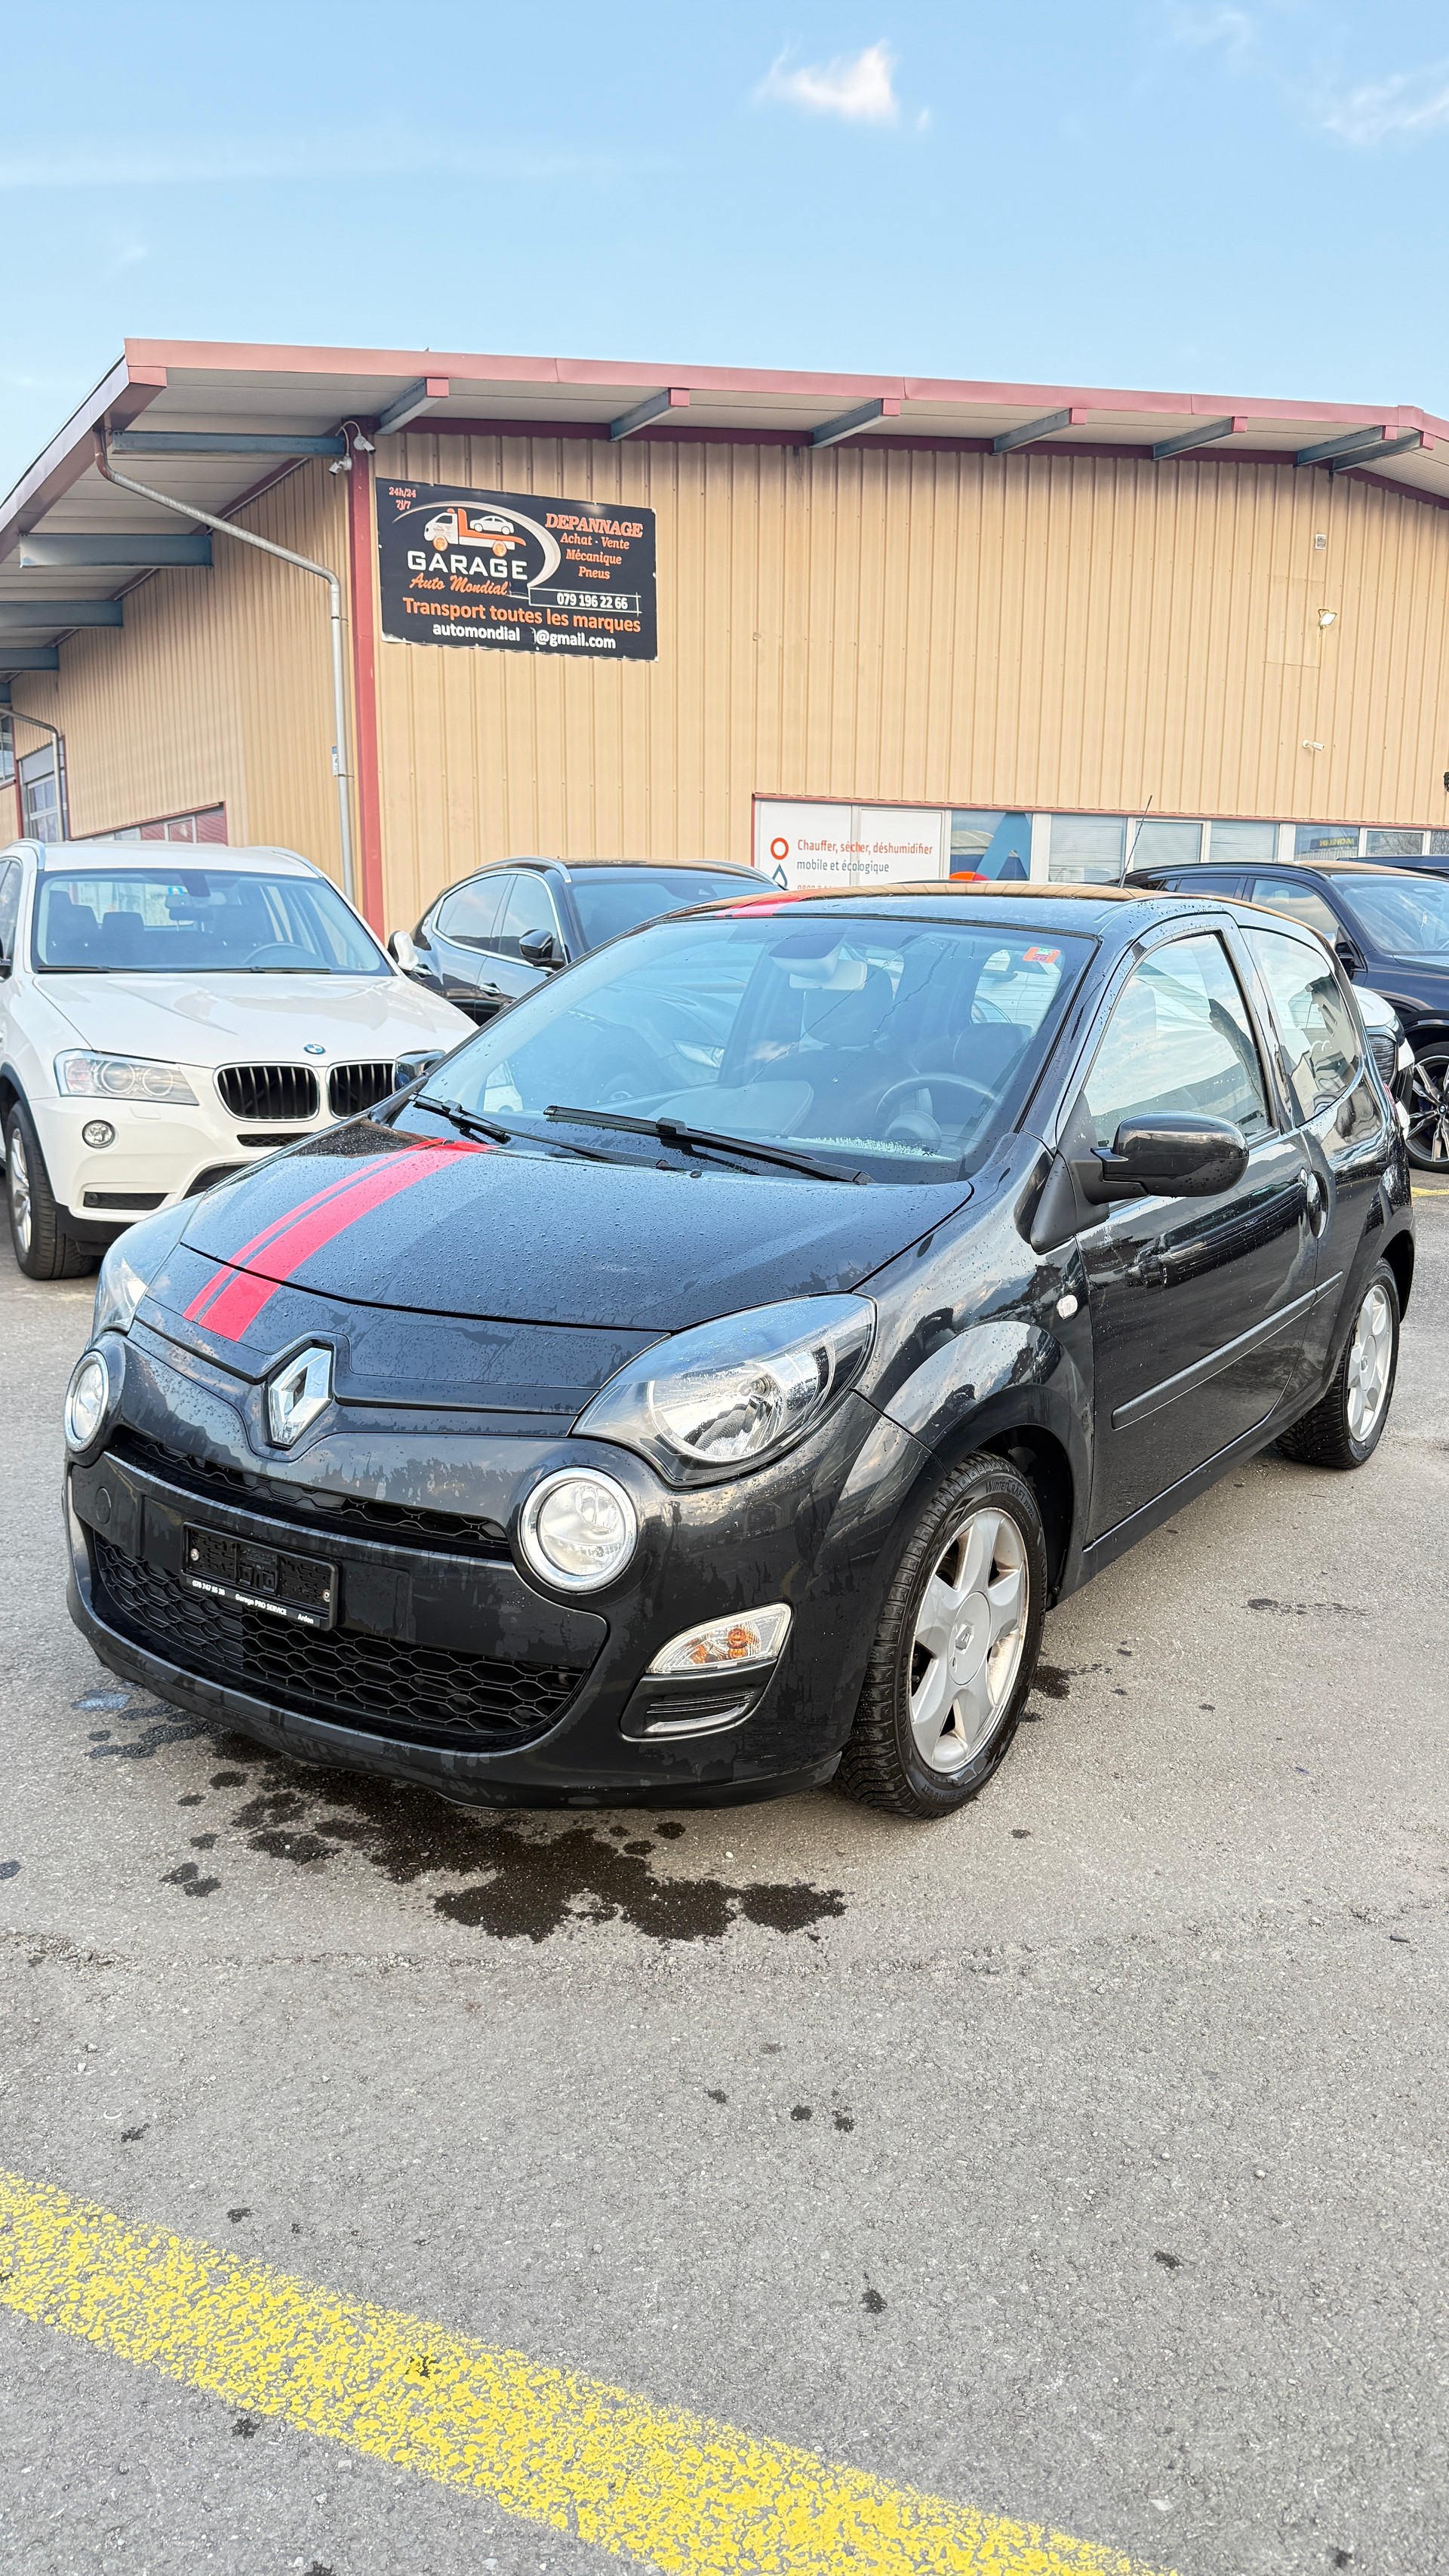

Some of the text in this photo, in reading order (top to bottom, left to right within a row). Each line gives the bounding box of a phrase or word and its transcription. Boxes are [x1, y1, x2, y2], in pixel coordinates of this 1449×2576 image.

[389, 486, 417, 498] 24h/24
[395, 499, 411, 511] 7j/7
[545, 513, 644, 538] DEPANNAGE
[560, 533, 592, 546] Achat
[601, 537, 630, 549] Vente
[407, 550, 528, 580] GARAGE
[566, 549, 623, 566] Mécanique
[578, 566, 611, 580] Pneus
[409, 572, 509, 596] Auto Mondial
[556, 592, 629, 610] 079 196 22 66
[402, 597, 641, 634] Transport toutes les marques
[797, 839, 934, 855] Chauffer, sécher, déshumidifier
[797, 859, 890, 874] mobile et écologique
[235, 1593, 254, 1606] Garage
[254, 1599, 266, 1609] PRO
[266, 1603, 288, 1615] SERVICE
